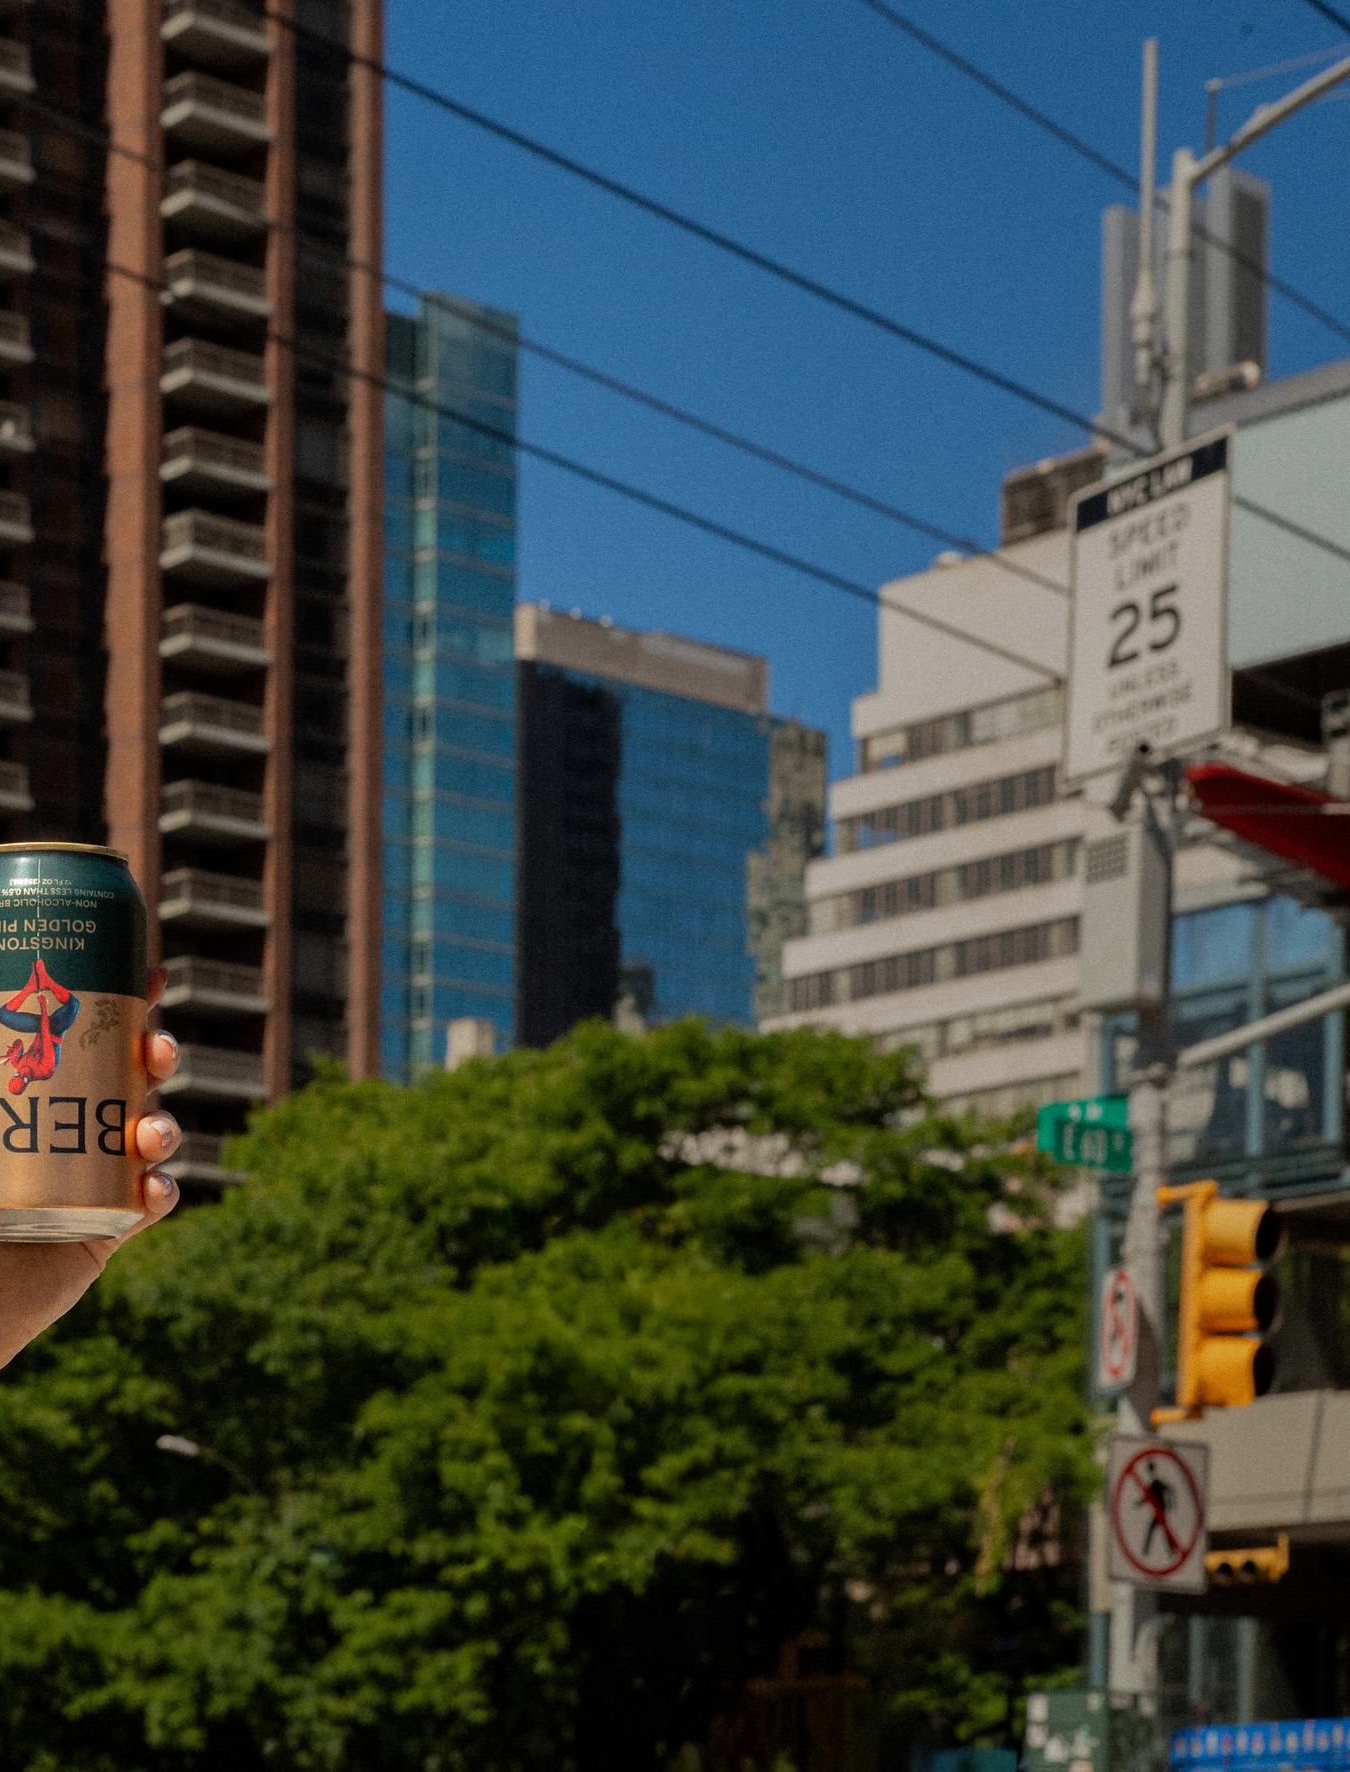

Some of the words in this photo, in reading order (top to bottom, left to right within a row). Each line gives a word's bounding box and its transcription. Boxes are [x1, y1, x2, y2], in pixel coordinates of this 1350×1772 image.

[1108, 502, 1190, 560] SPEED
[1114, 539, 1178, 591] LIMIT
[1108, 583, 1182, 671] 25
[1, 887, 22, 897] 0.5%
[23, 887, 50, 896] THAN
[50, 888, 73, 896] LESS
[74, 888, 115, 899] CONTAINS
[13, 898, 97, 908] NON-ALCOHOLIC
[24, 919, 97, 934] GOLDEN
